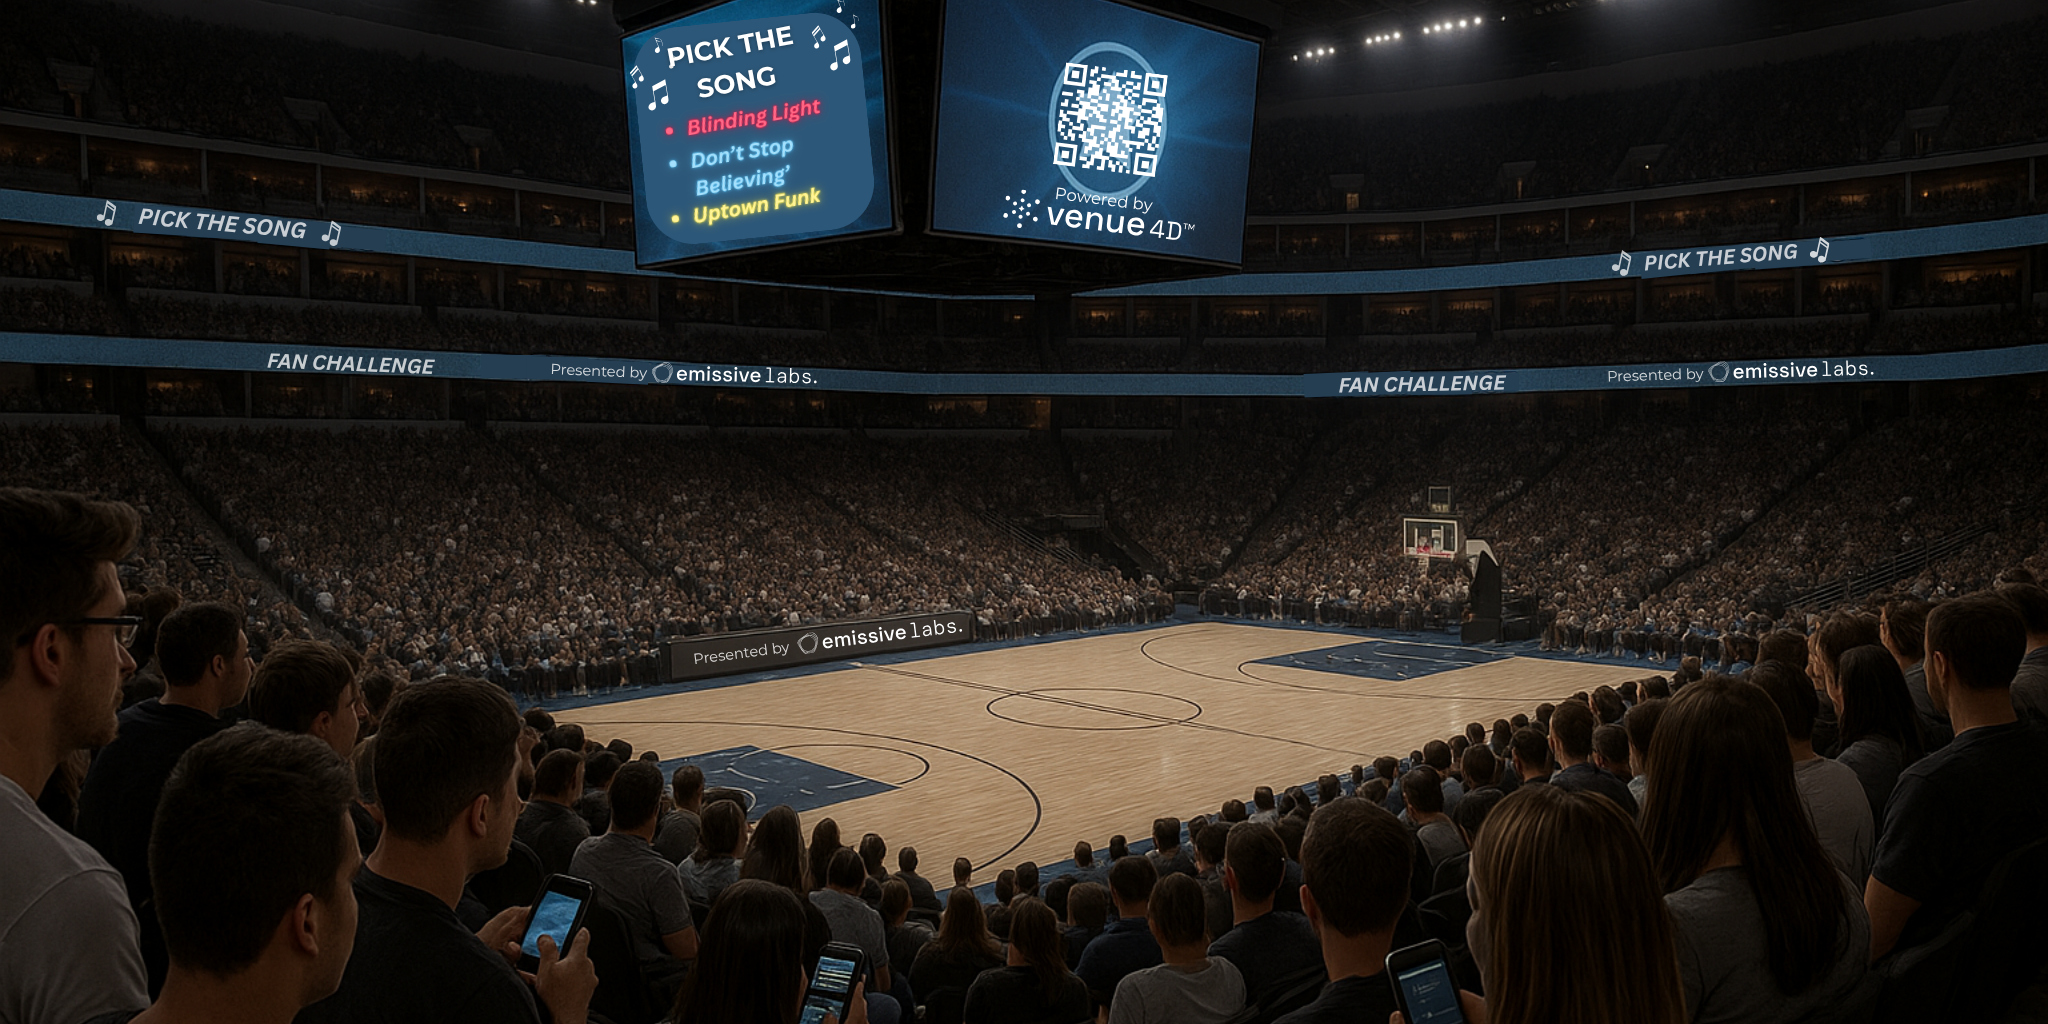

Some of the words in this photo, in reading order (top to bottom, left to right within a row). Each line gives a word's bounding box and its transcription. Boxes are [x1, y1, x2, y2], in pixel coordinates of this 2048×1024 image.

[667, 36, 734, 69] PICK
[737, 25, 794, 53] THE
[697, 66, 776, 98] SONG
[687, 108, 767, 136] Blinding
[772, 99, 821, 123] Light
[691, 145, 744, 169] Don’t
[749, 139, 794, 158] Stop
[693, 199, 769, 226] Uptown
[774, 187, 821, 209] Funk
[1055, 187, 1128, 208] Powered
[1133, 196, 1153, 214] by
[138, 208, 192, 229] PICK
[196, 213, 240, 233] THE
[242, 217, 307, 239] SONG
[1047, 206, 1145, 236] venue
[1644, 251, 1692, 271] PICK
[1696, 248, 1736, 267] THE
[1739, 243, 1798, 263] SONG
[267, 353, 308, 370] FAN
[312, 354, 436, 375] CHALLENGE
[550, 363, 626, 379] Presented
[630, 366, 648, 382] by
[676, 366, 762, 383] emissive
[765, 367, 818, 384] labs.
[1608, 367, 1682, 383] Presented
[1686, 368, 1704, 383] by
[1732, 362, 1818, 380] emissive
[1821, 360, 1875, 377] labs.
[1338, 376, 1379, 394] FAN
[1384, 374, 1507, 393] CHALLENGE
[693, 642, 769, 665] Presented
[772, 642, 790, 657] by
[822, 627, 907, 649] emissive
[910, 619, 964, 639] labs.
